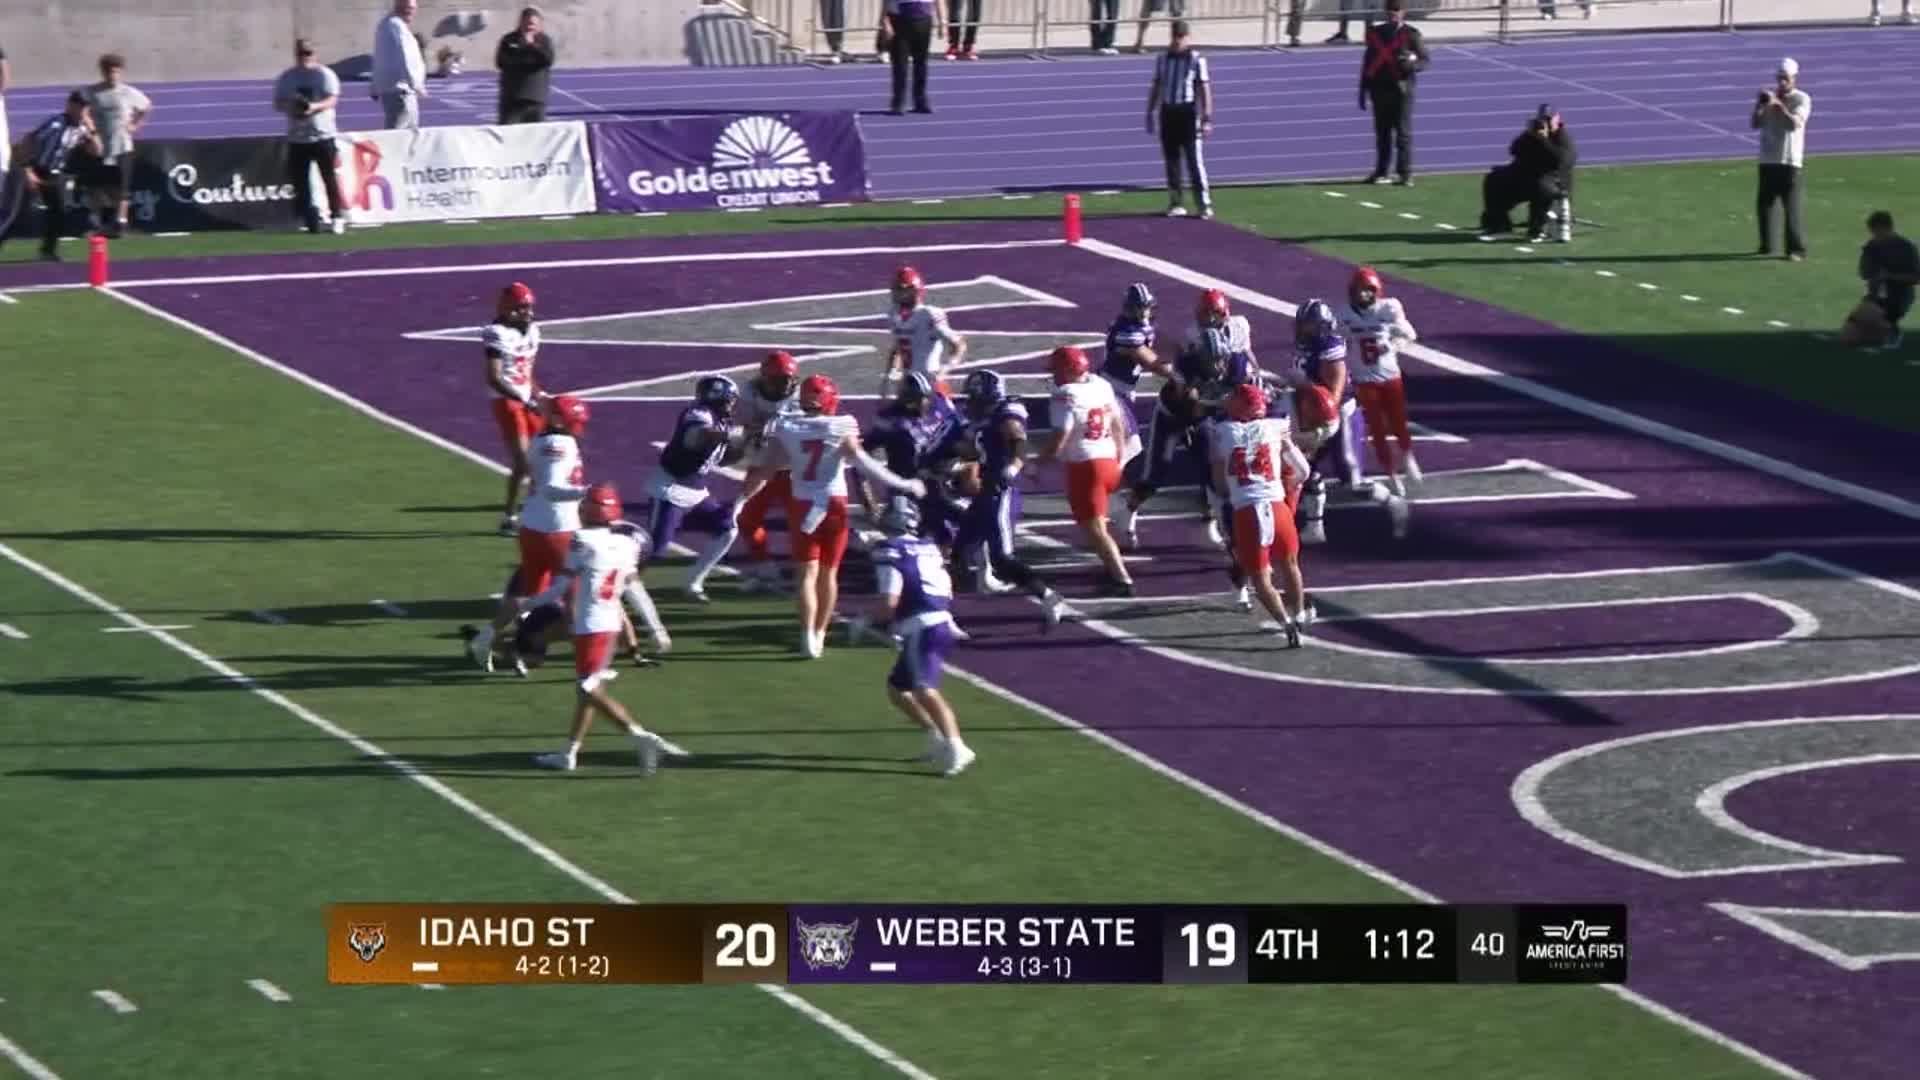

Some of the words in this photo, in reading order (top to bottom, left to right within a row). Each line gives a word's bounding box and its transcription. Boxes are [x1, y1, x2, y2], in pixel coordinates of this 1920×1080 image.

[167, 164, 297, 204] Couture
[402, 158, 573, 186] Intermountain
[627, 160, 834, 196] Goldenwest
[406, 186, 482, 209] Health
[716, 193, 768, 208] CREDIT
[770, 190, 822, 206] UNION
[799, 437, 825, 482] 7
[1228, 438, 1276, 487] 44
